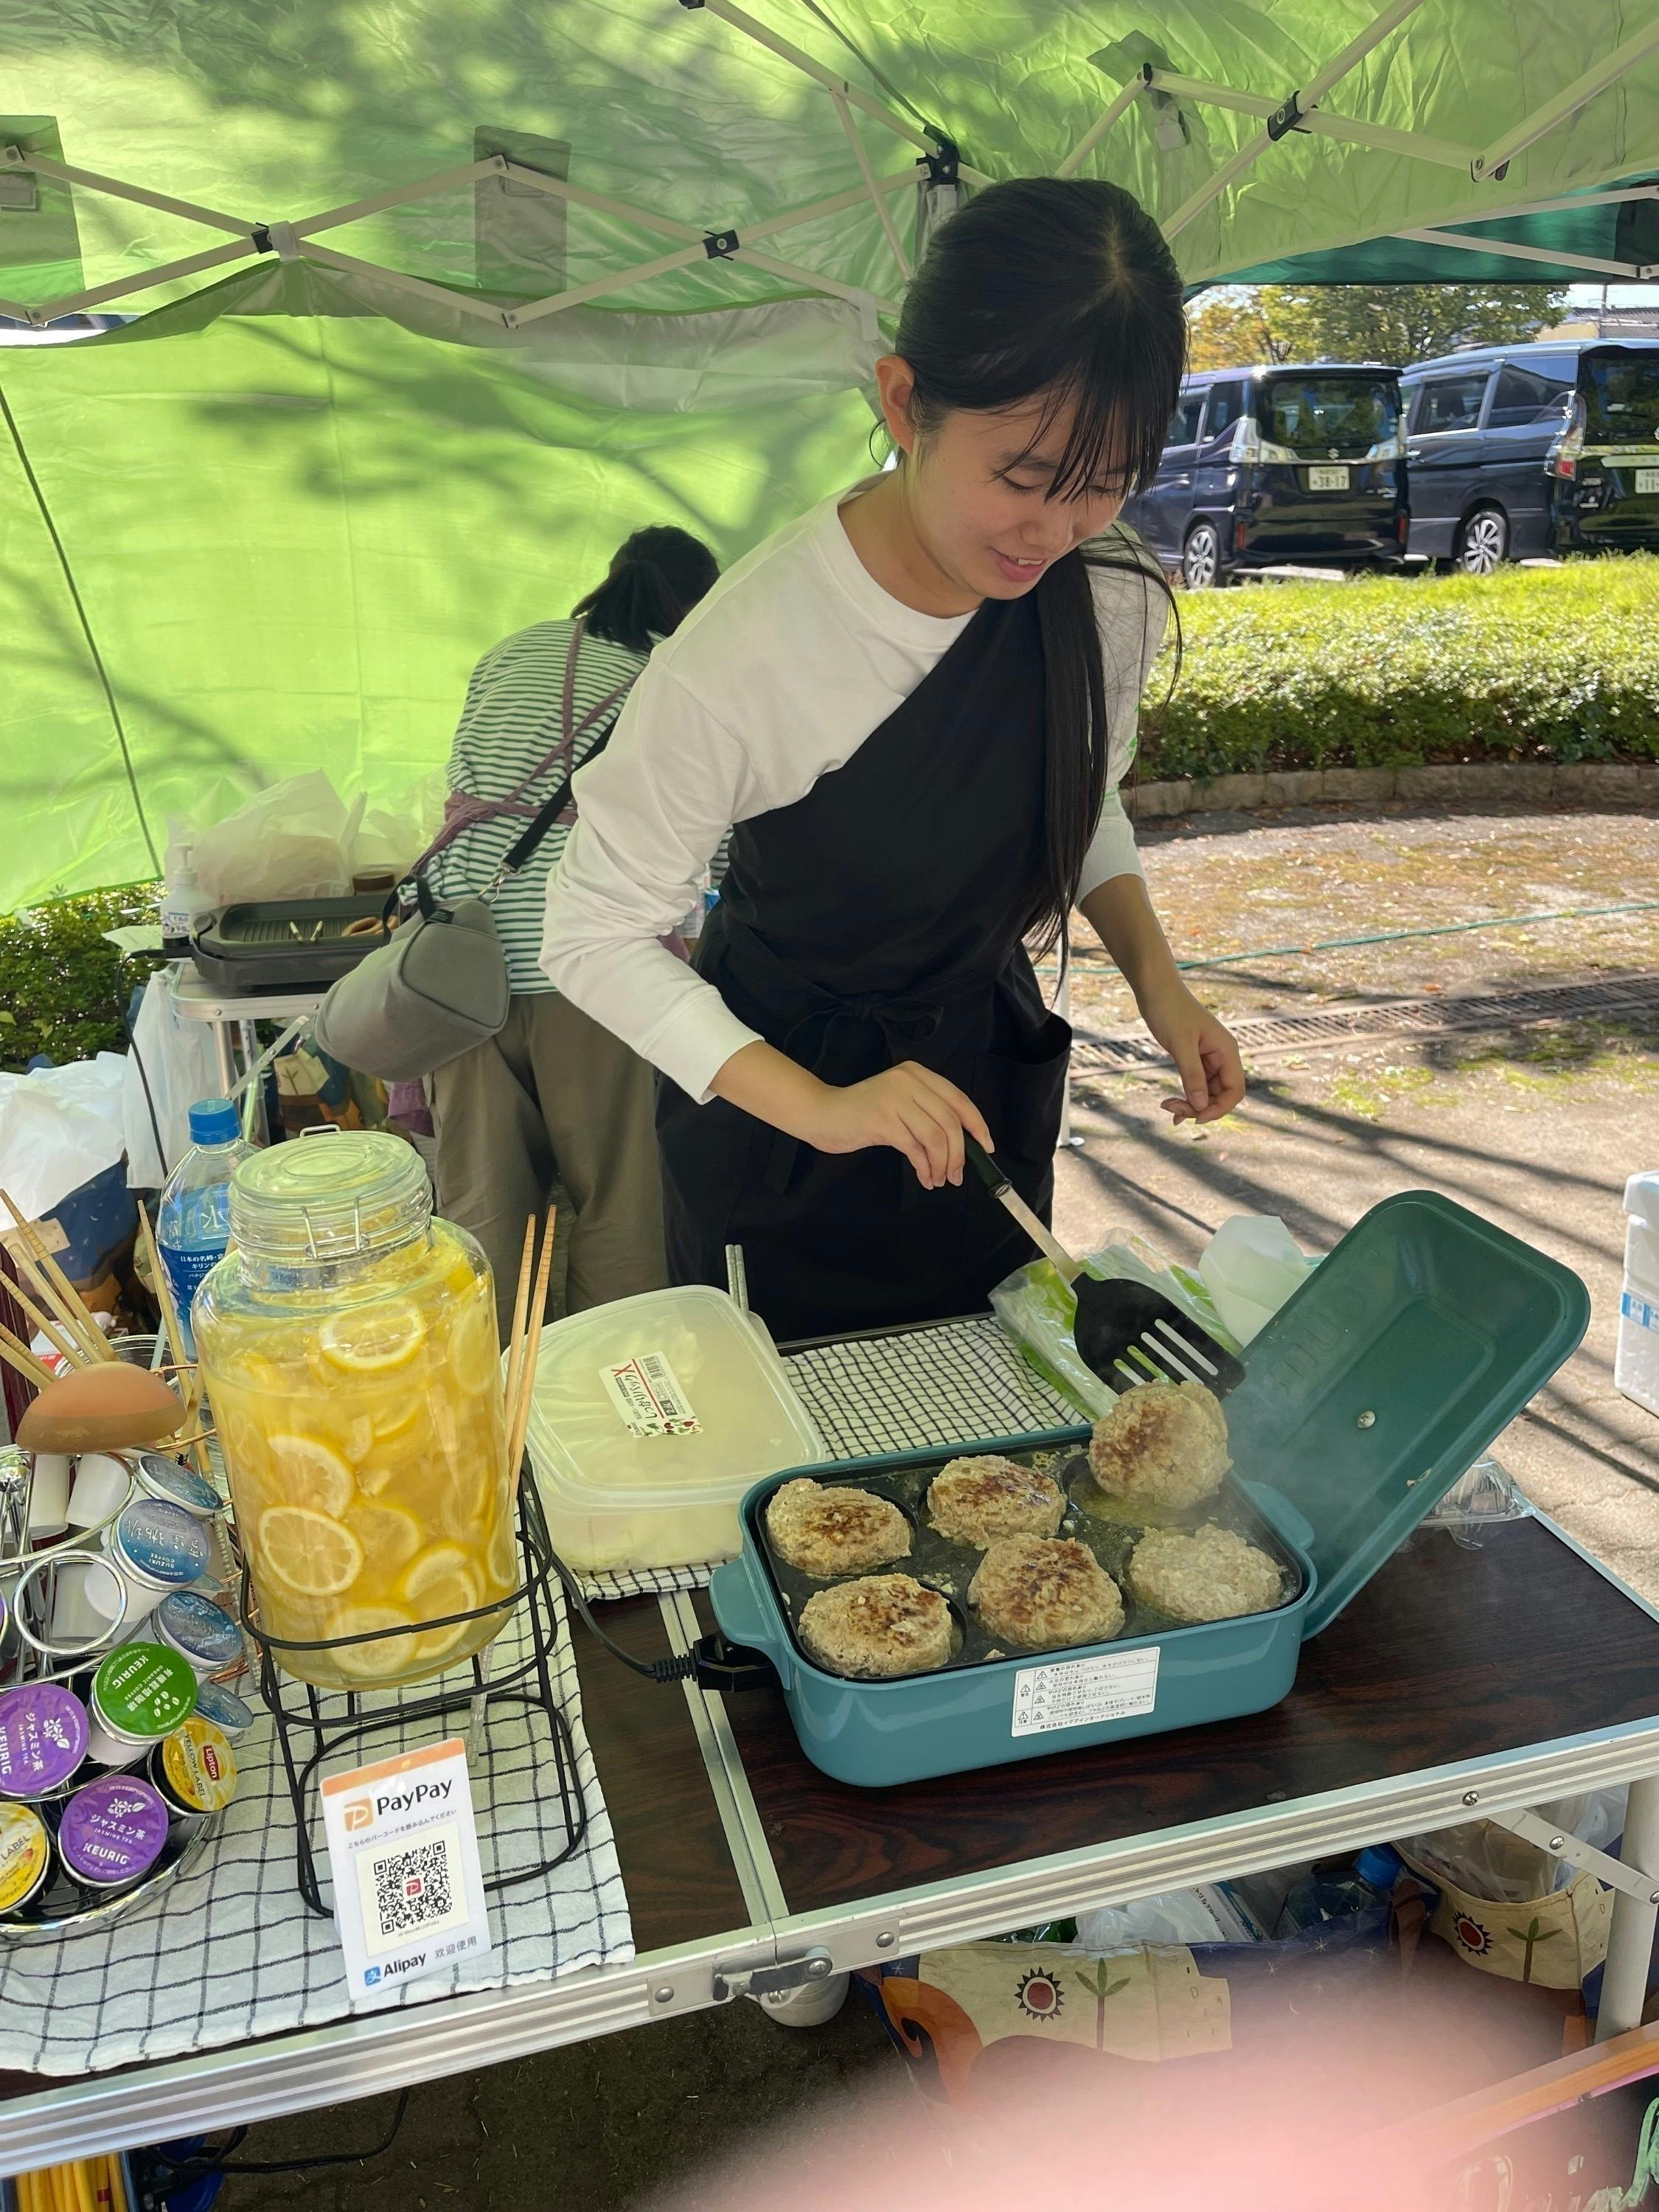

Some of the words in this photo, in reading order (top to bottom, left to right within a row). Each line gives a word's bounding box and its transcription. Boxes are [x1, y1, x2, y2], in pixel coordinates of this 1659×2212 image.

[149, 1557, 175, 1569] SUZUKI
[112, 1655, 150, 1689] KEURIG
[142, 1665, 164, 1684] ORGANIC
[124, 1684, 143, 1701] COFFEE
[127, 1668, 173, 1711] 有機栽培珈琲
[25, 1712, 44, 1772] ジャスミン茶
[184, 1735, 199, 1769] YELLOW
[194, 1770, 206, 1797] LABEL
[205, 1747, 218, 1778] Lipton
[377, 1778, 453, 1815] PayPay
[90, 1814, 146, 1840] ジャスミン茶
[121, 1835, 133, 1844] TEA
[1, 1834, 30, 1860] LABEL
[83, 1843, 131, 1865] KEURIG
[434, 1935, 478, 1959] 欢迎使用
[383, 1952, 426, 1978] Alipay
